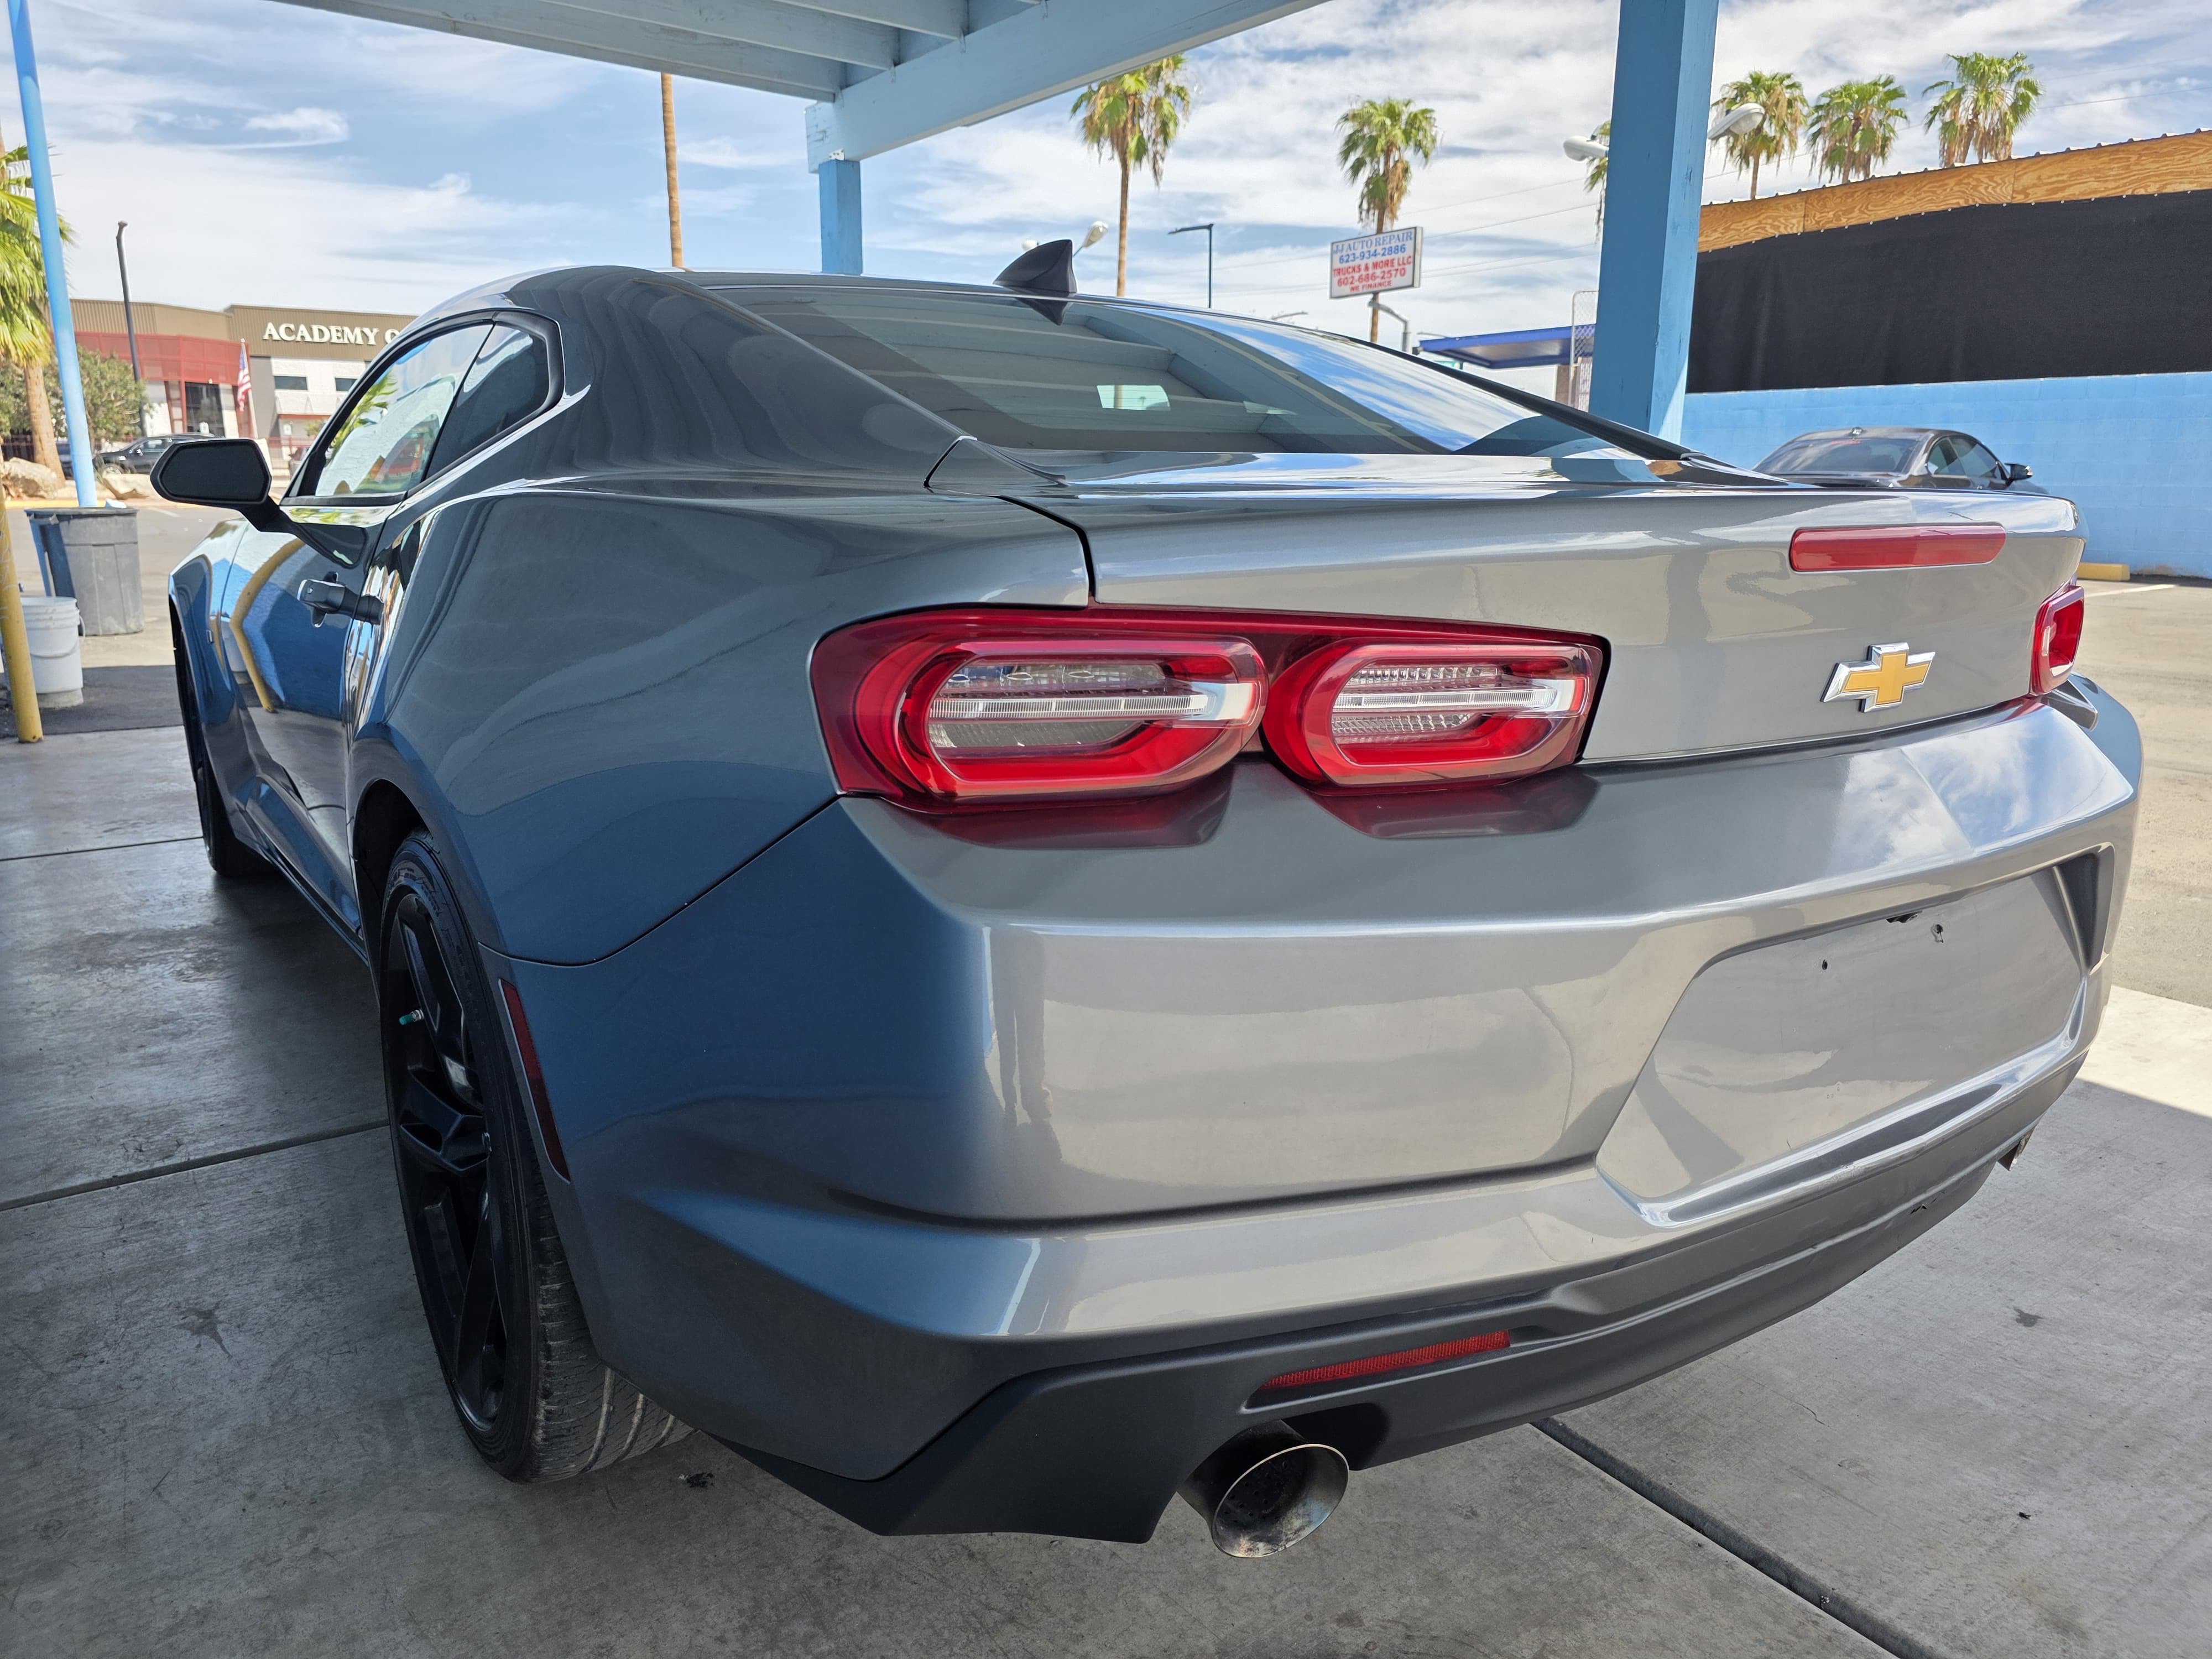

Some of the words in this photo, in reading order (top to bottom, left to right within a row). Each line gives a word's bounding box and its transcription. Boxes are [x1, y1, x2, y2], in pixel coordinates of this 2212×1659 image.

[1346, 239, 1373, 252] AUTO
[1375, 231, 1413, 247] REPAIR
[1339, 244, 1406, 264] 623-934-2886
[1333, 264, 1361, 277] TRUCKS
[1364, 263, 1369, 272] &
[1372, 258, 1395, 270] MORE
[1397, 255, 1412, 266] LLC
[1337, 268, 1406, 286] 602-686-2570
[1362, 280, 1392, 290] FINANCE
[262, 322, 379, 345] ACADEMY
